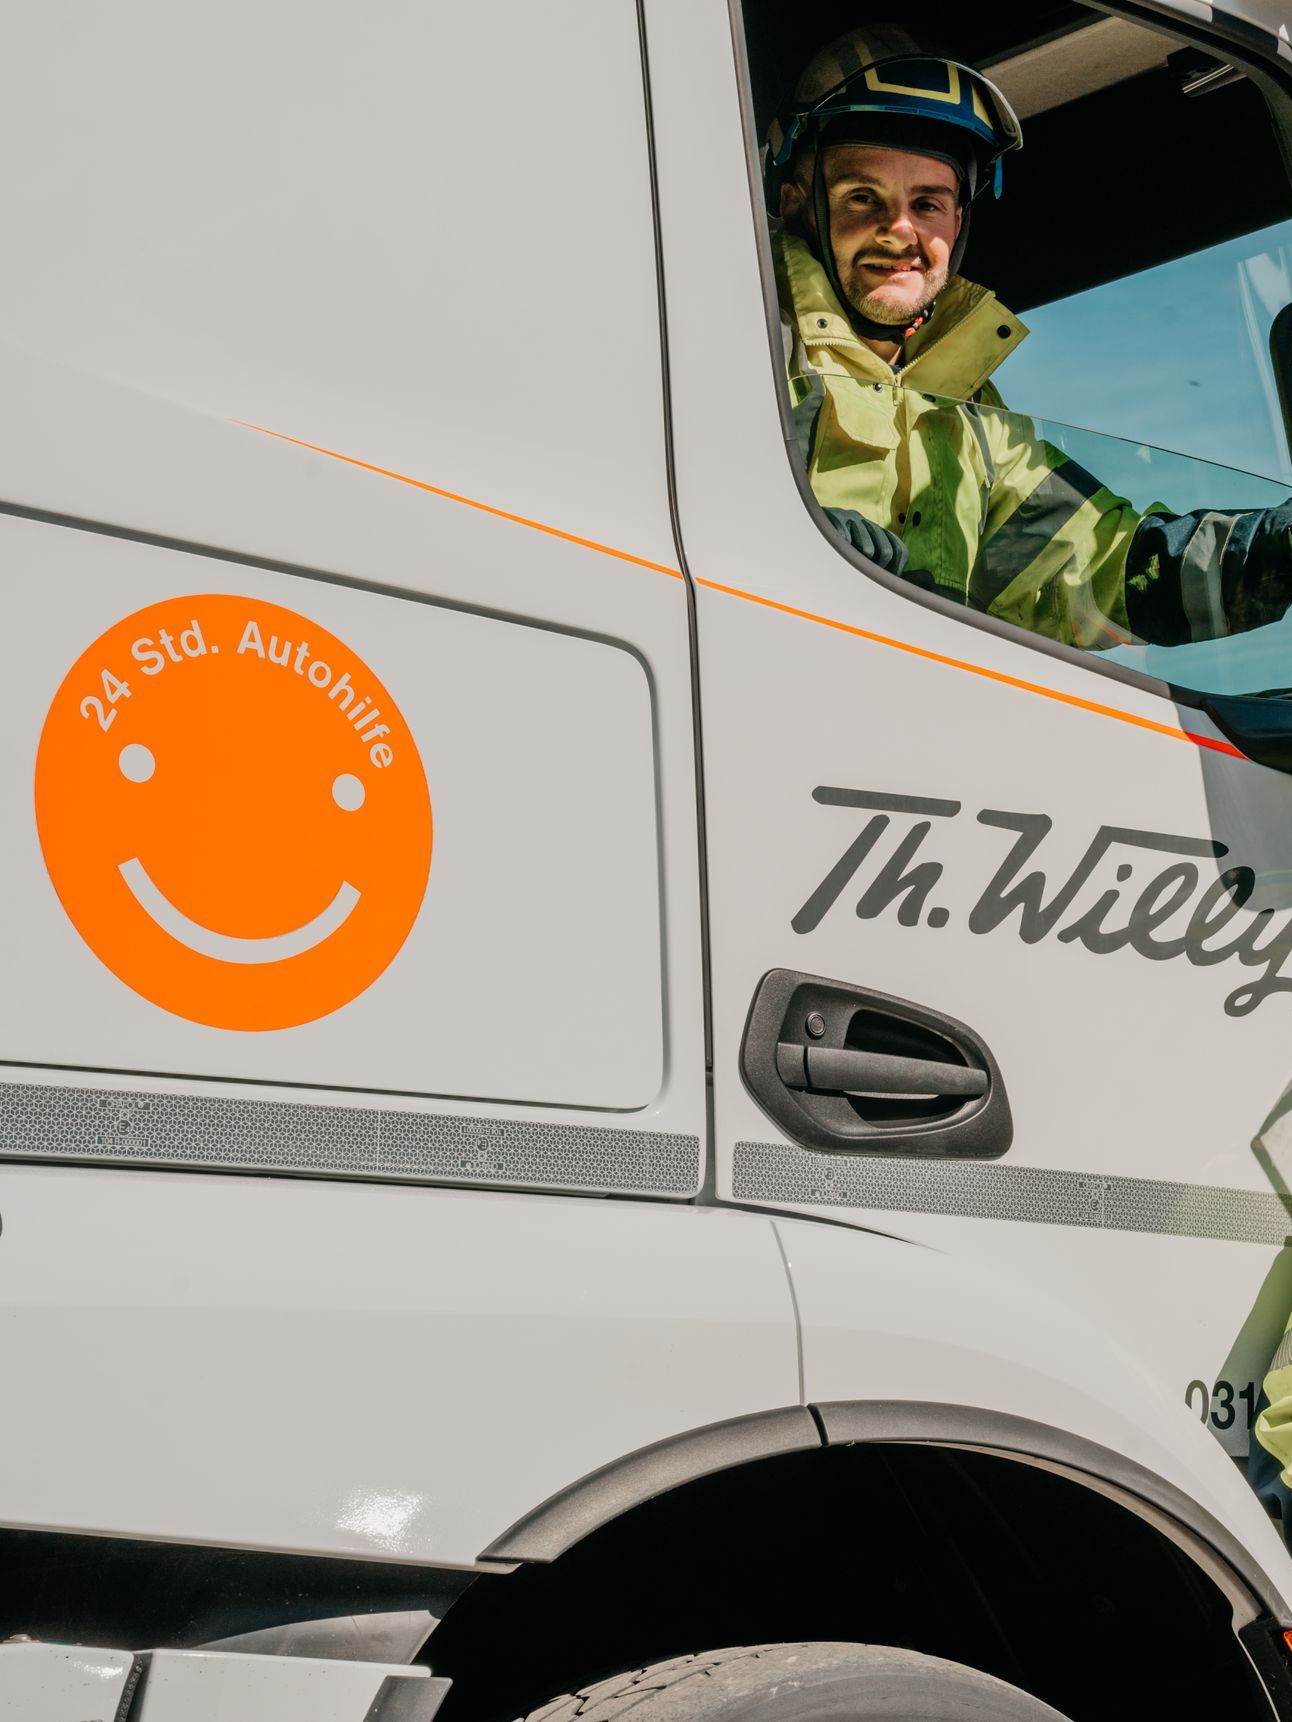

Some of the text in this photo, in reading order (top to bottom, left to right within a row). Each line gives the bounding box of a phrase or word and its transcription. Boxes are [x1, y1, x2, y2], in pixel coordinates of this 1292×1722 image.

[80, 619, 394, 768] 24 Std. Autohilfe
[791, 785, 962, 935] Th.
[1184, 1379, 1256, 1431] 031
